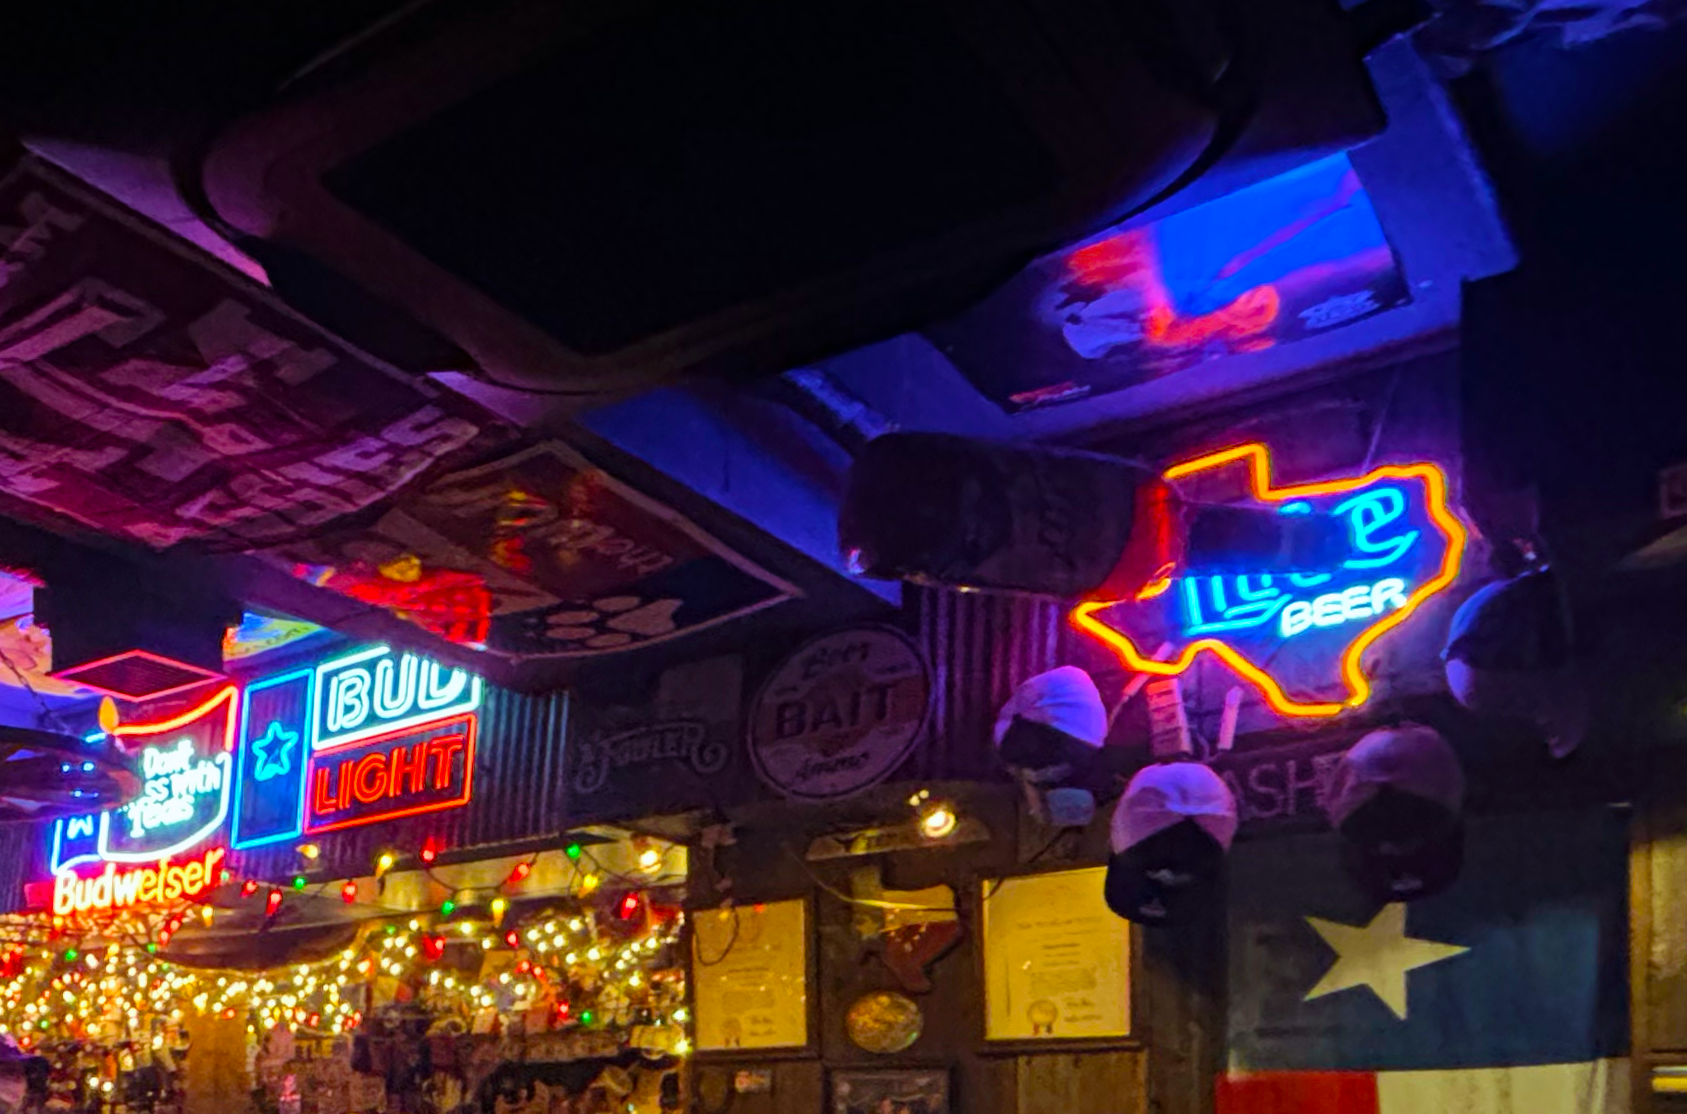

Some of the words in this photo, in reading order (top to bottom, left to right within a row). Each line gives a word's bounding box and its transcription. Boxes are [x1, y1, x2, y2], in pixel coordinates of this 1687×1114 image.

[1280, 577, 1408, 639] BEER
[327, 652, 467, 732] BUD
[775, 685, 897, 741] BAIT
[315, 732, 467, 815] LIGHT
[54, 846, 225, 915] Budweiser
